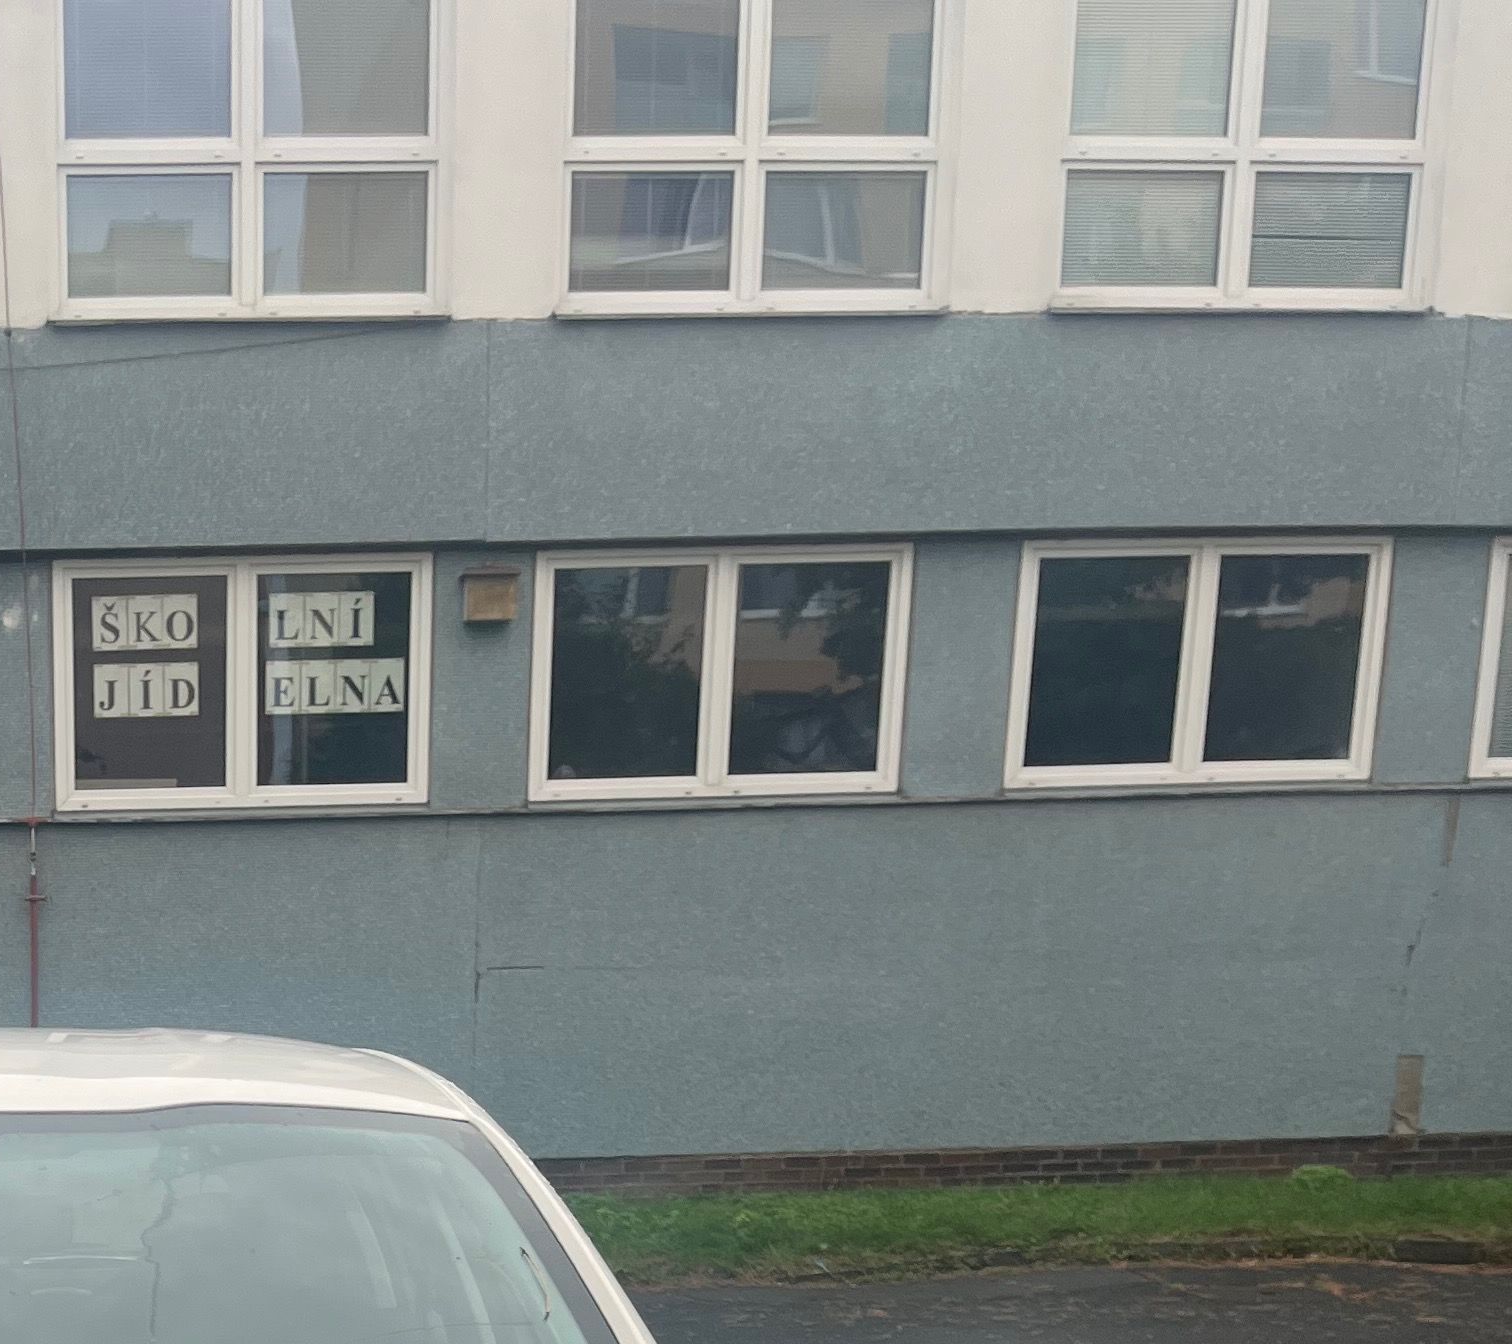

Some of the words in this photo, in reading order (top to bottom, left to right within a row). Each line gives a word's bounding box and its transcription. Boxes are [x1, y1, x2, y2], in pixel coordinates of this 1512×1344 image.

[99, 602, 195, 645] ŠKO
[274, 598, 364, 640] LNÍ
[98, 669, 196, 712] JÍD
[271, 674, 402, 708] ELNA
